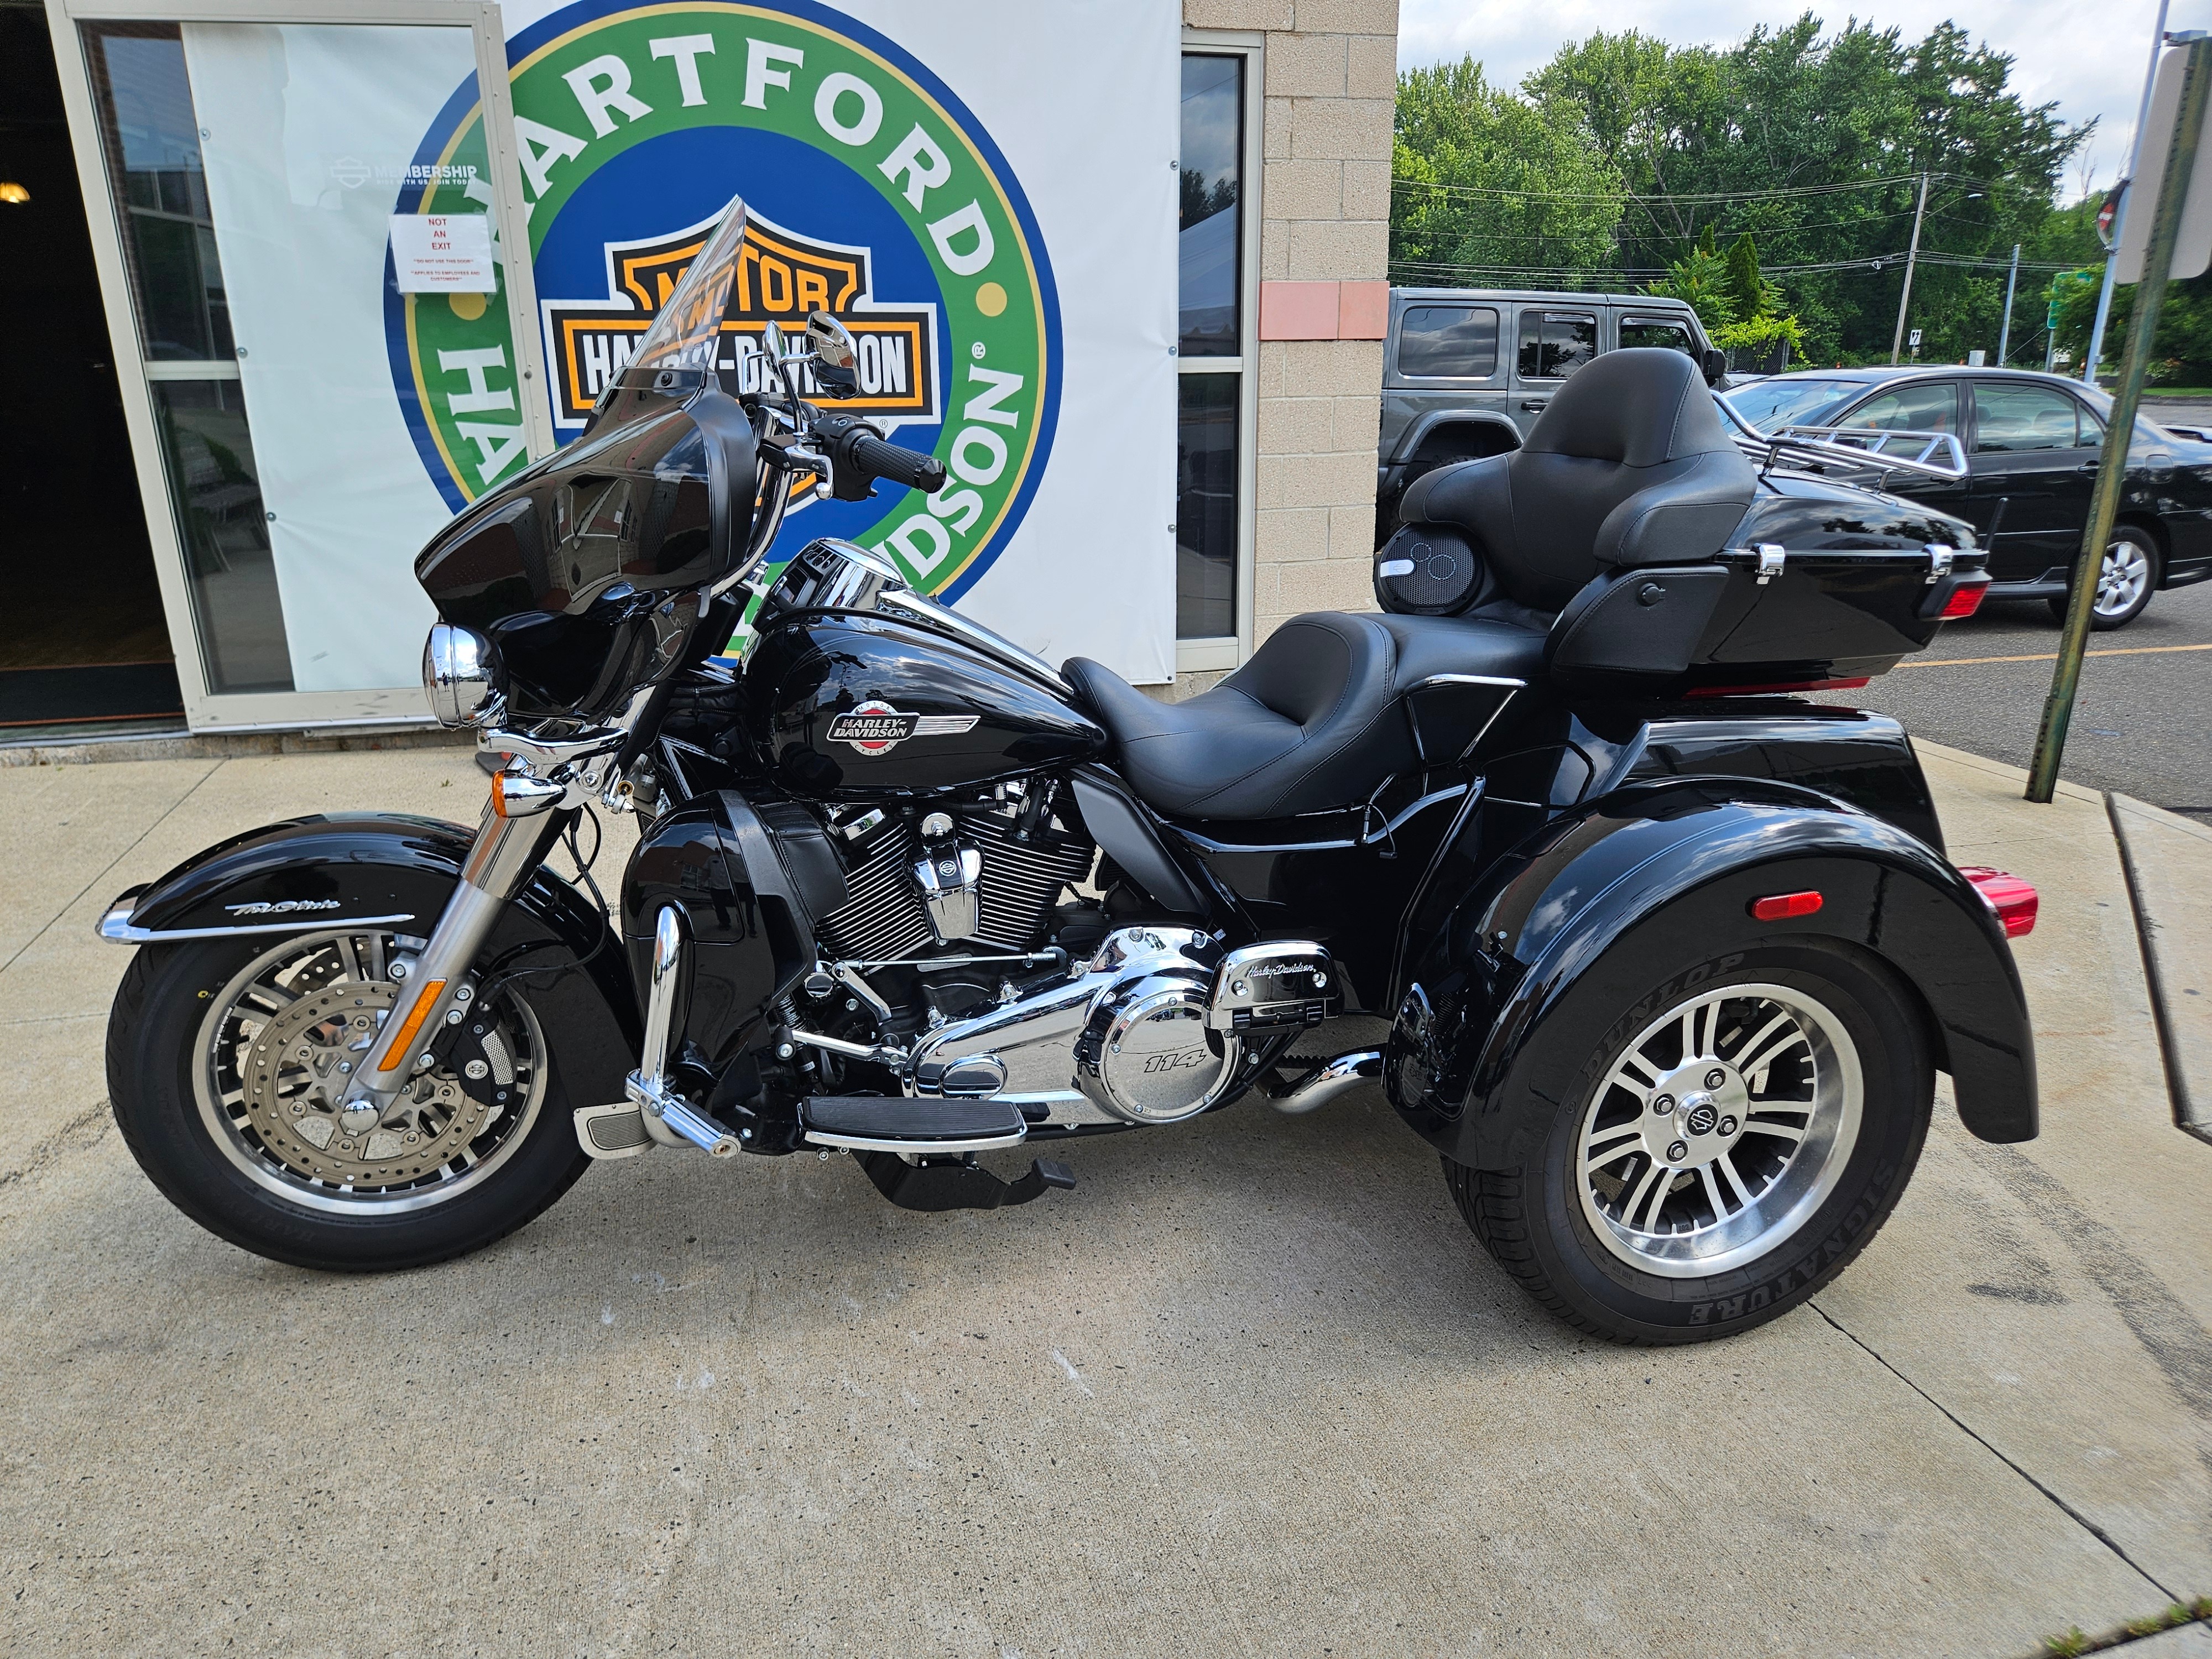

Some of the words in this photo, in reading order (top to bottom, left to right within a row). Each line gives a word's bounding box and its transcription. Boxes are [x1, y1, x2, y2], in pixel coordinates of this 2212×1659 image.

[375, 165, 477, 179] MEMBERSHIP
[858, 702, 889, 712] MOTOR
[841, 719, 907, 728] HARLEY-
[833, 728, 907, 737] DAVIDSON
[854, 744, 893, 755] CYCLES
[1582, 953, 1745, 1084] DUNLOP
[1144, 1048, 1207, 1073] 114
[1688, 1159, 1895, 1324] SIGNATURE
